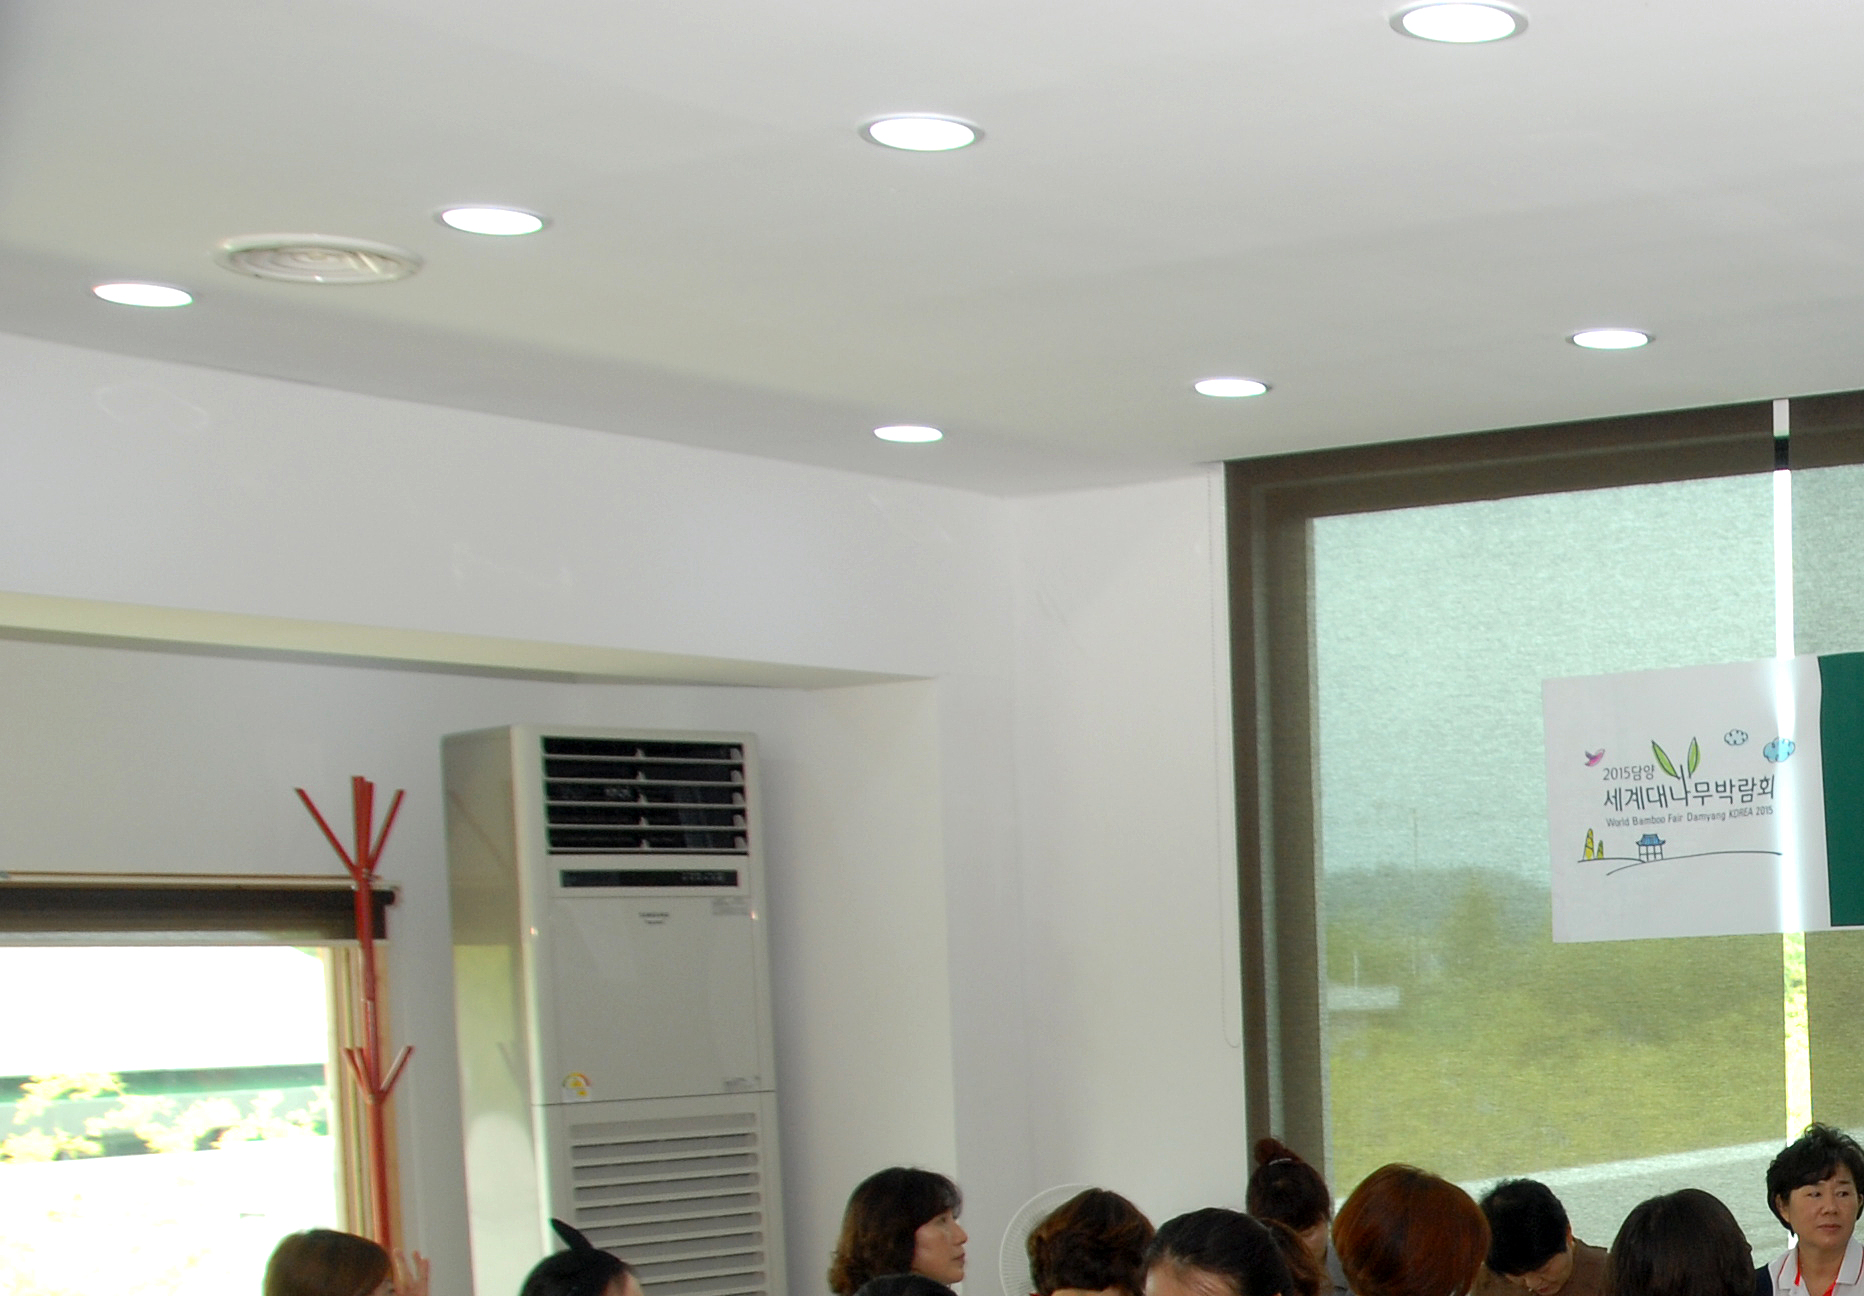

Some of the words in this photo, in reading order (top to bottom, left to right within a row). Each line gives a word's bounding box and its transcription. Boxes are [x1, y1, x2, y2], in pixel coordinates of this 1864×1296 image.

[1602, 764, 1655, 781] 2015담양
[1603, 764, 1776, 812] 세계대나무박람회
[1606, 816, 1630, 828] World
[1632, 814, 1666, 826] Bamboo
[1668, 812, 1684, 823] Fair
[1687, 810, 1726, 823] Damyang
[1728, 807, 1754, 819] KOREA
[1755, 805, 1774, 816] 2015
